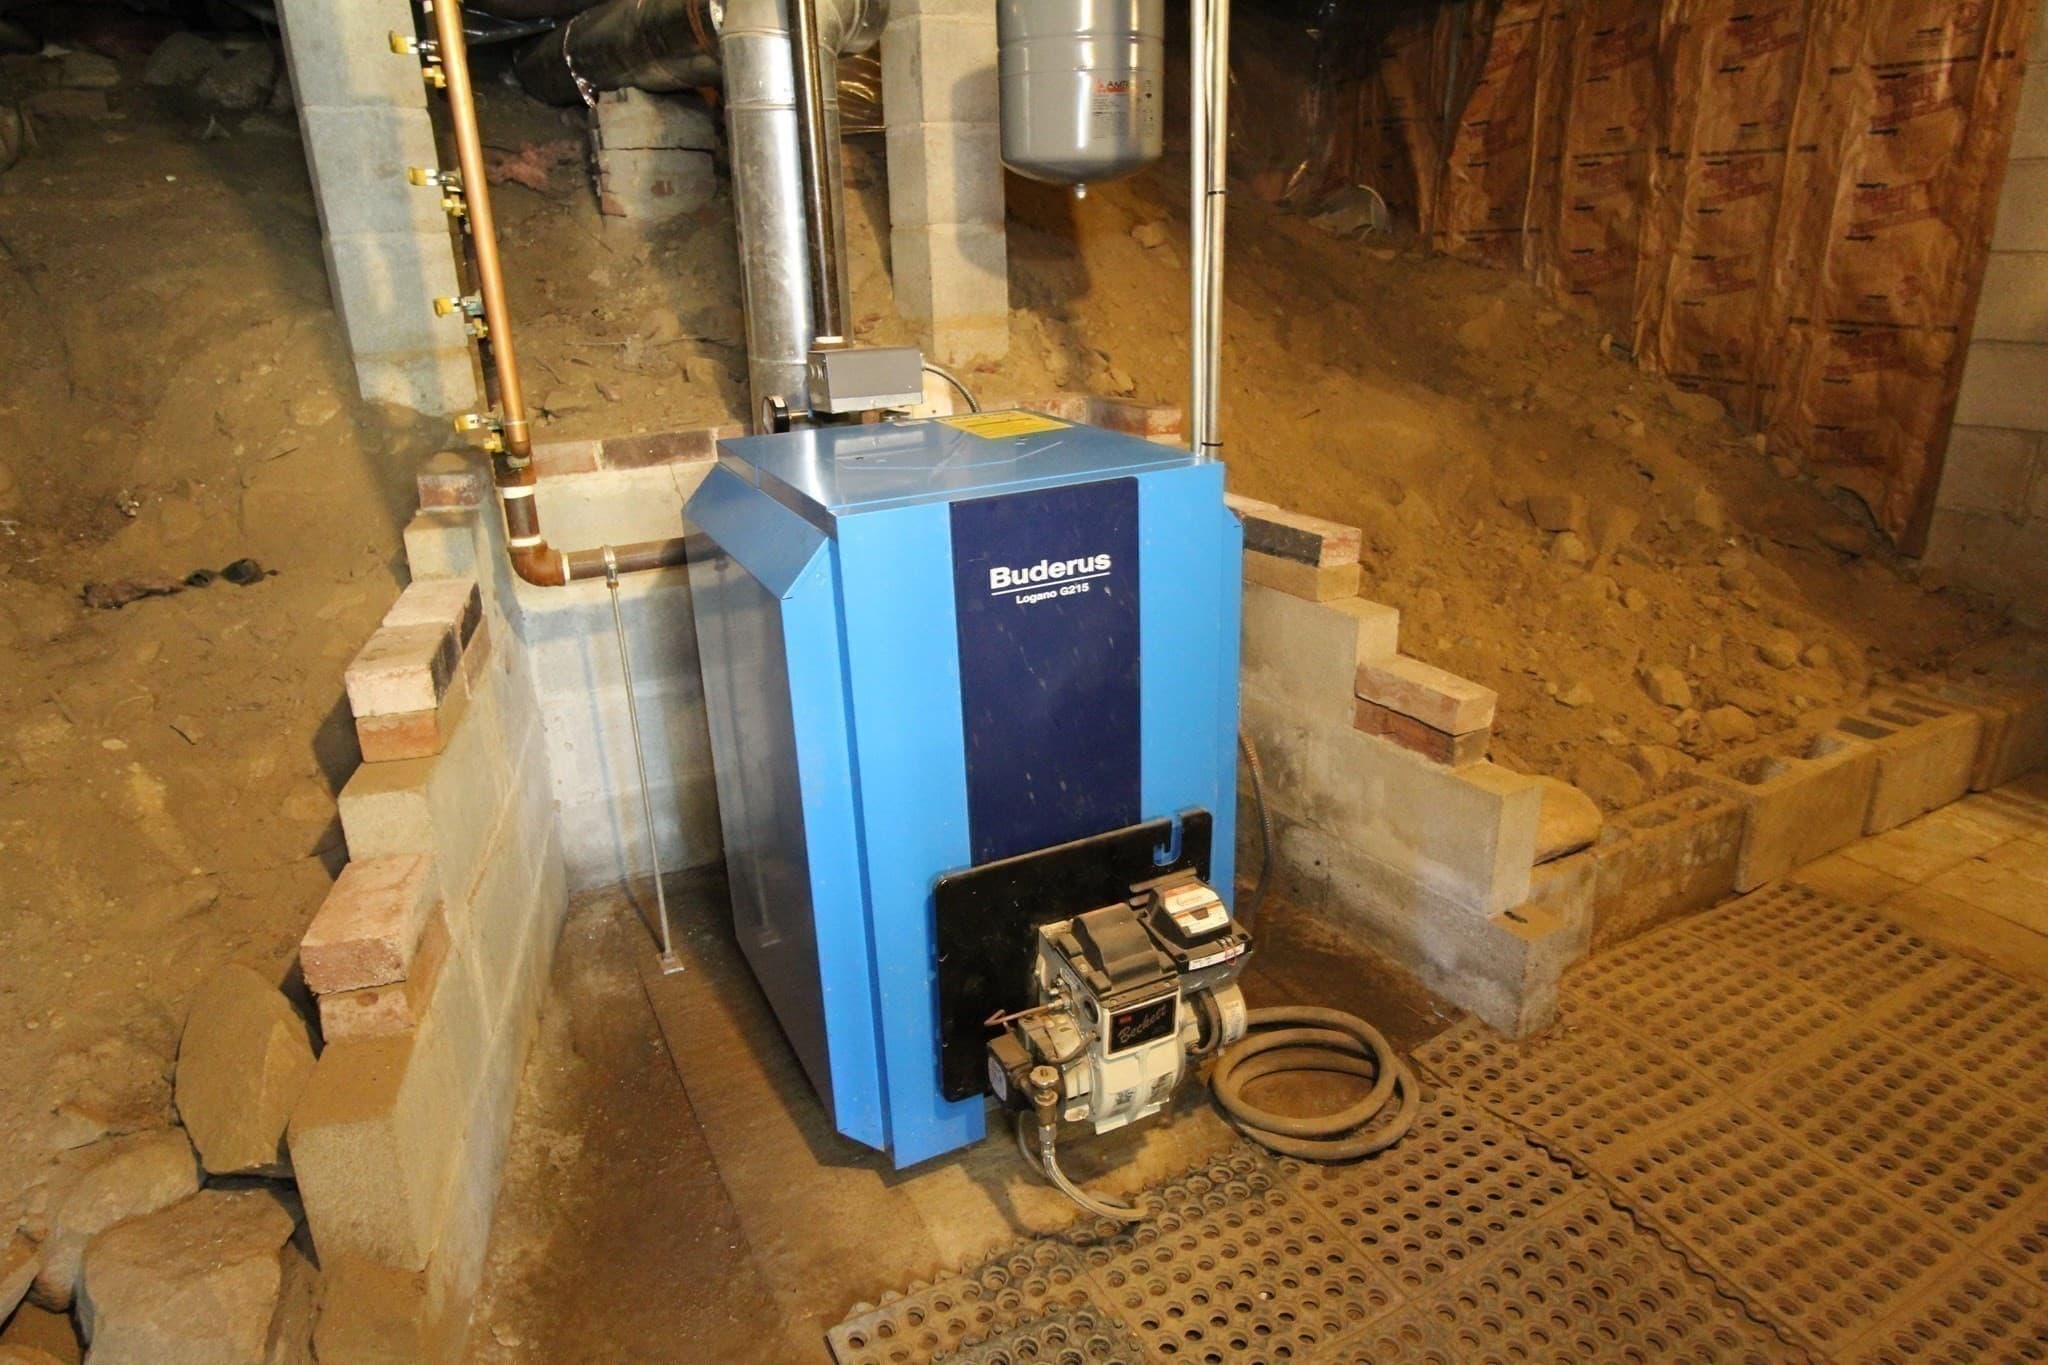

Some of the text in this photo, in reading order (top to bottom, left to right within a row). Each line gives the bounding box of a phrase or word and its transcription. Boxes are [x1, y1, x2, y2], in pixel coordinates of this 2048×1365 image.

[989, 553, 1112, 590] Buderus
[1015, 582, 1090, 604] Logano G215
[1116, 1003, 1168, 1044] Beckett
